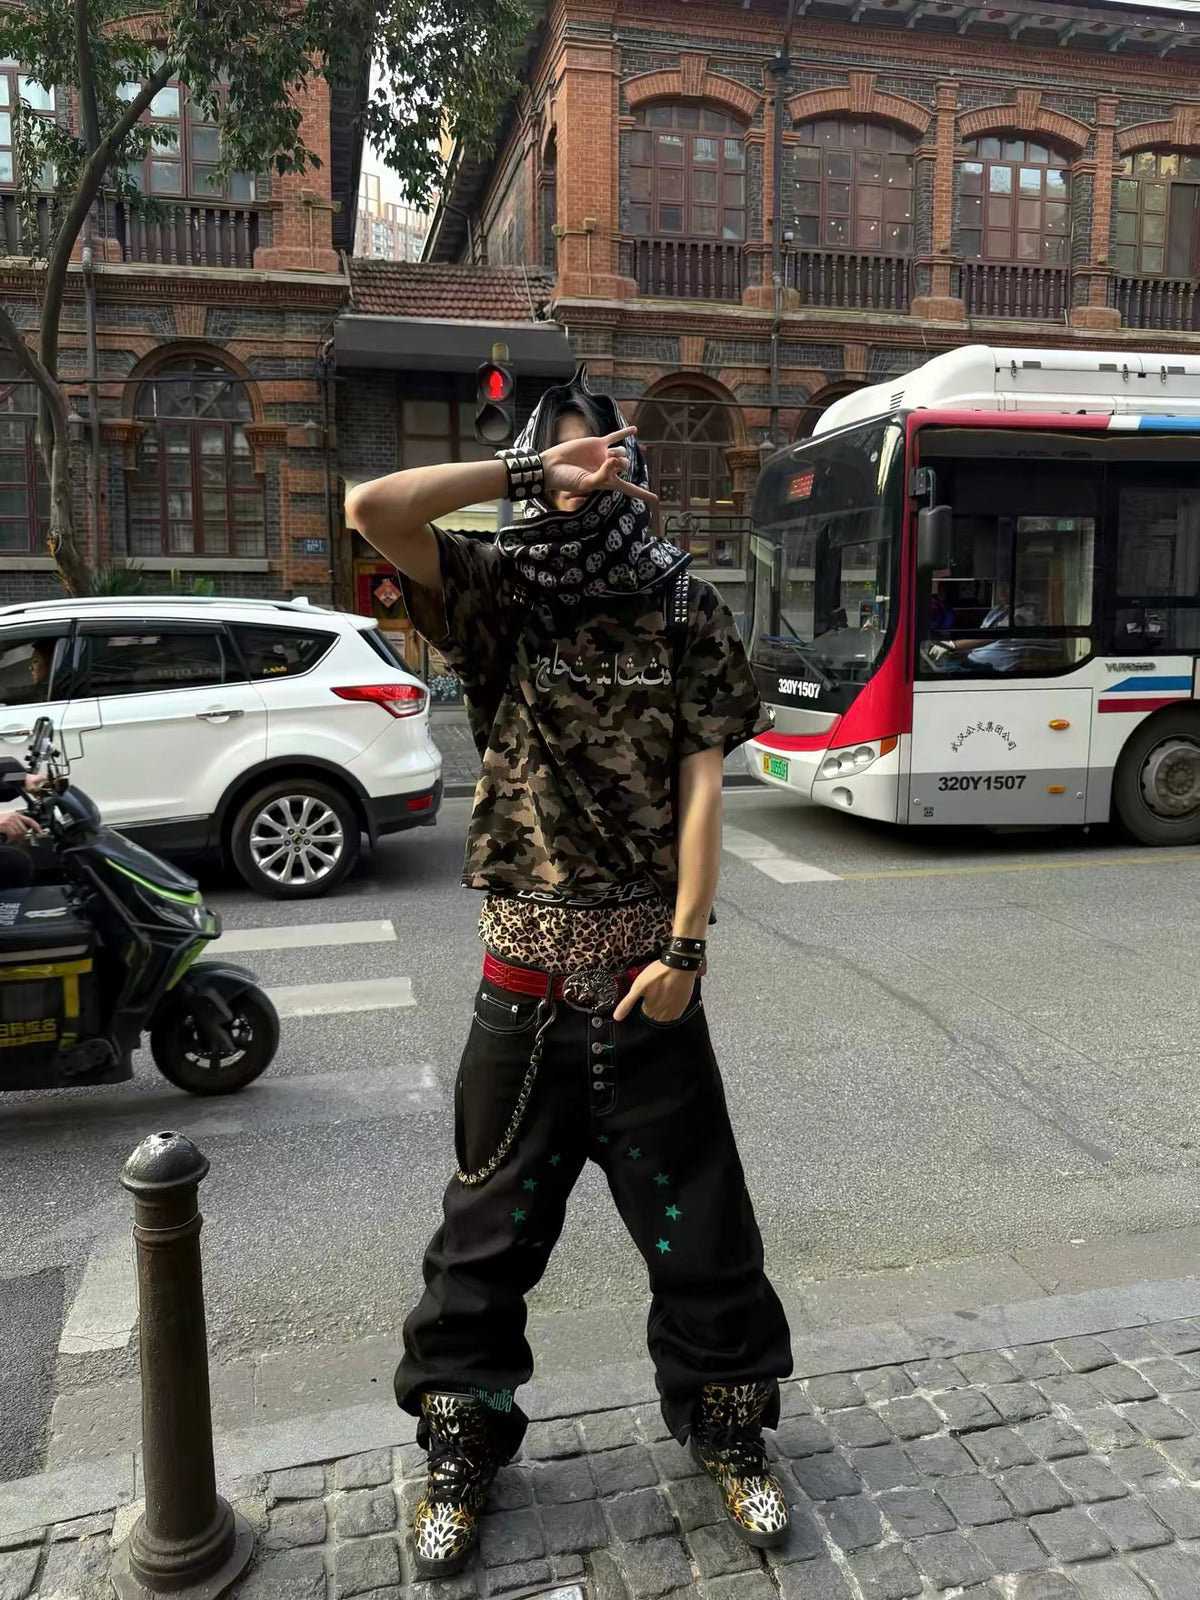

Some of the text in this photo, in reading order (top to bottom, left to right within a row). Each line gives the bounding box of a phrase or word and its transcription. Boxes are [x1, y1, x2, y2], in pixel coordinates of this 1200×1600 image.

[777, 678, 820, 699] 320Y1507
[950, 720, 1017, 753] 武汉公交集团公司
[937, 775, 1027, 792] 320Y1507
